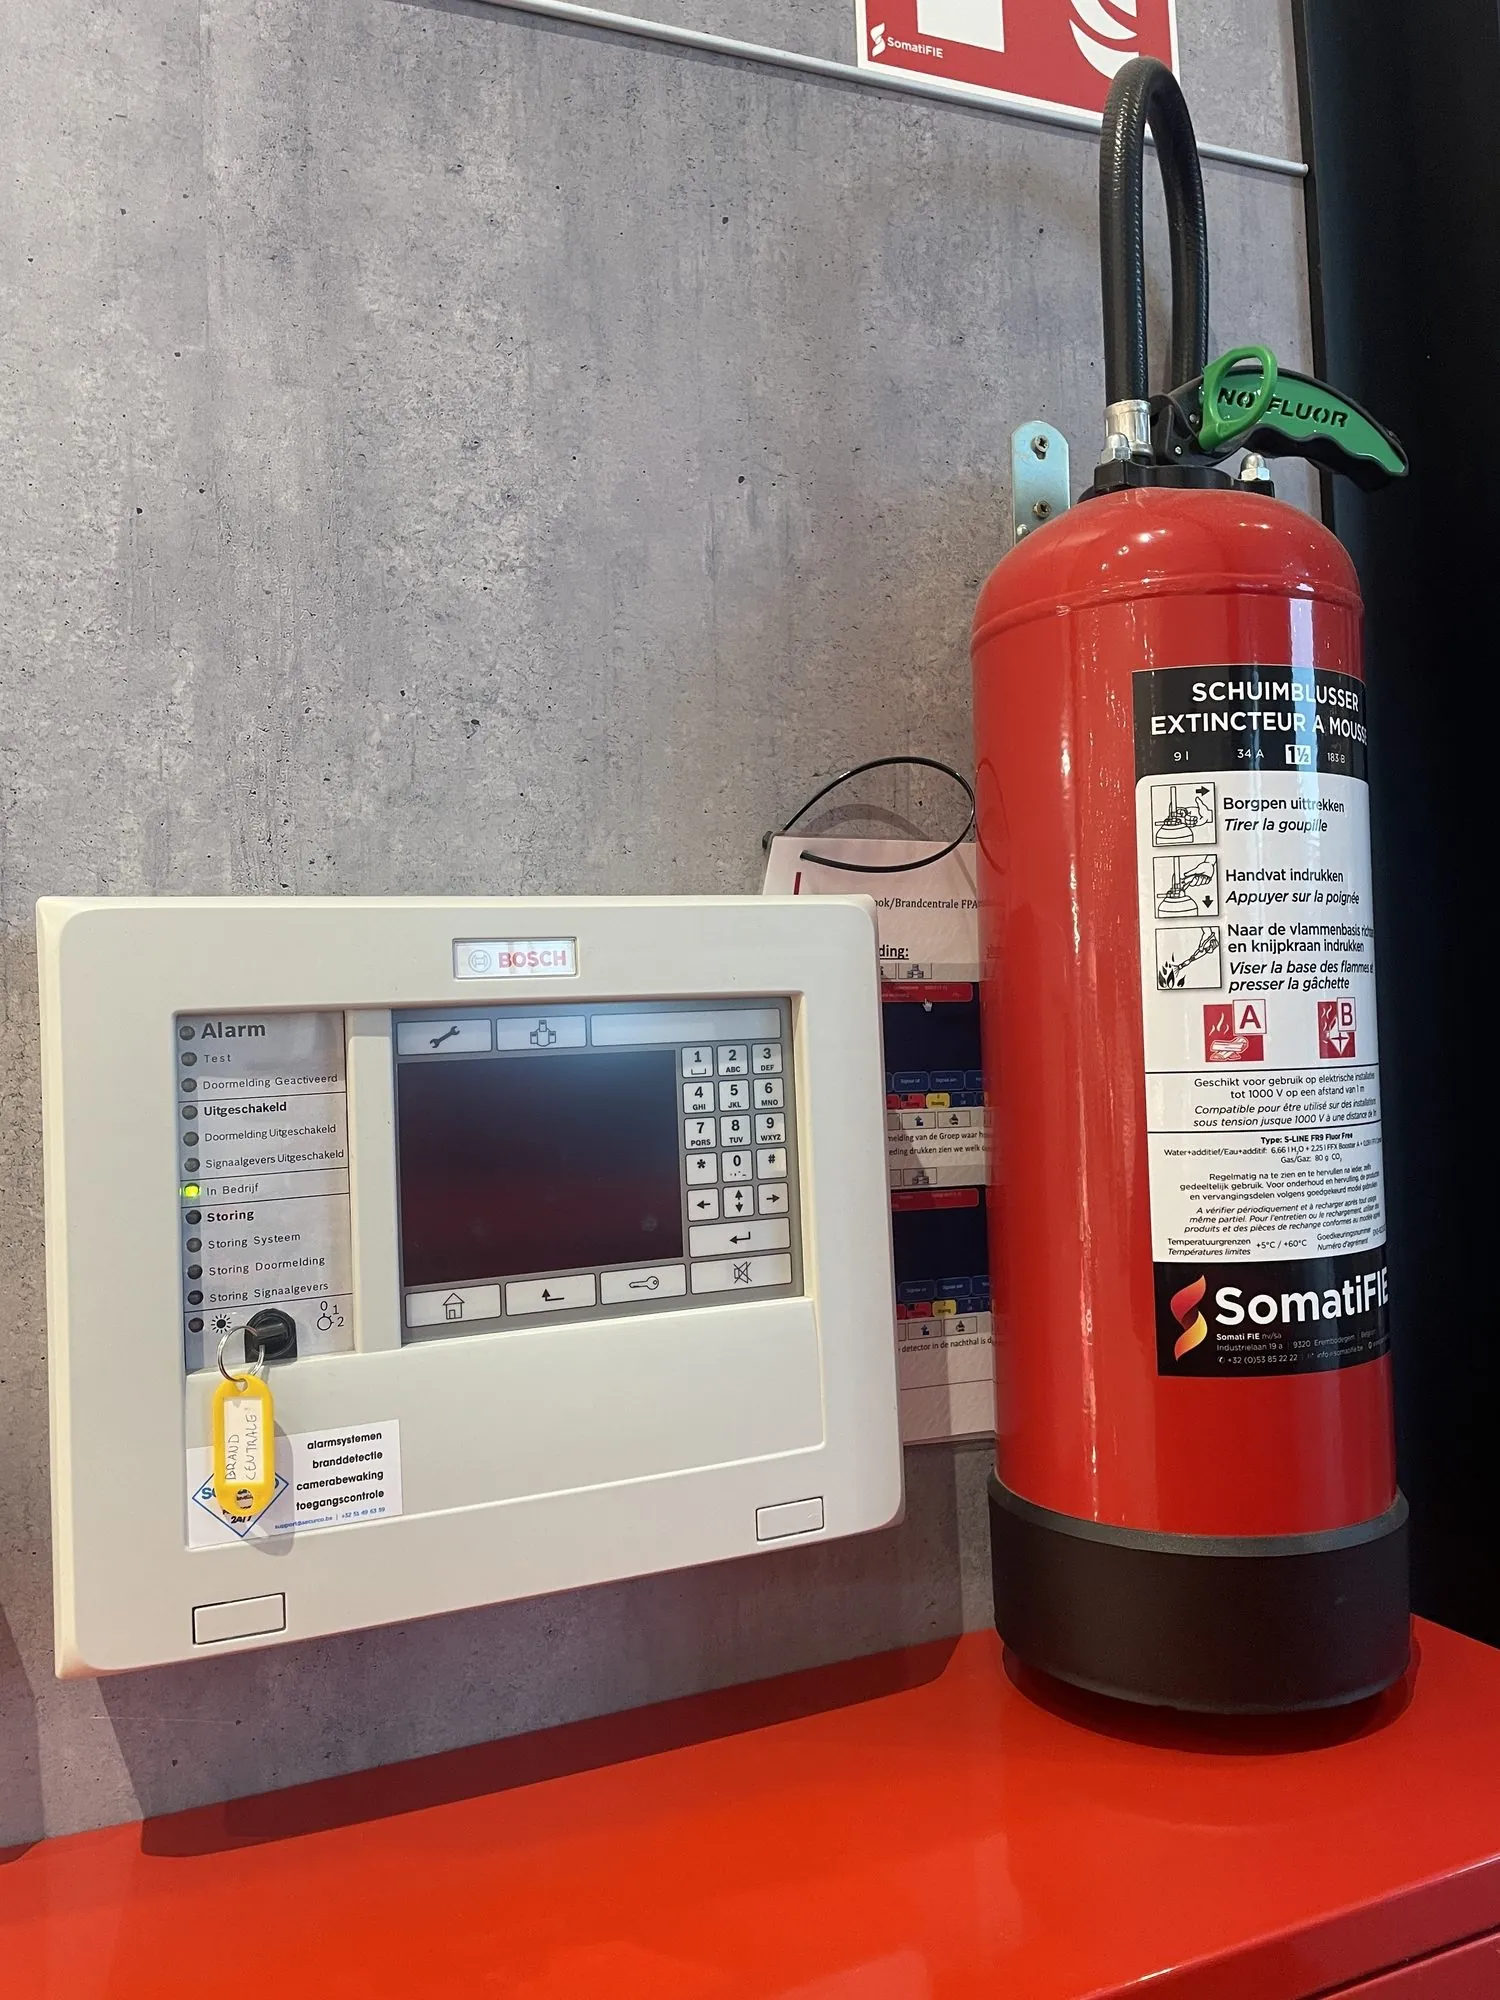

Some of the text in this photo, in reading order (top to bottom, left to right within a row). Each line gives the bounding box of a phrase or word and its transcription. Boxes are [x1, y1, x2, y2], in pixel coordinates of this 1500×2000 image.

[887, 36, 944, 59] SomatiFIE
[1218, 387, 1348, 427] NO FLUOR
[1192, 681, 1359, 711] SCHUIMBLUSSER
[1151, 712, 1305, 735] EXTINCTEUR
[1312, 715, 1325, 733] A
[1174, 752, 1181, 761] 9
[1237, 749, 1251, 758] 34
[1256, 750, 1264, 758] A
[1328, 753, 1339, 762] 183
[1341, 755, 1345, 763] B
[1224, 797, 1344, 813] Borgpen uittrekken
[1224, 818, 1327, 833] Tirer la goupille
[1226, 869, 1343, 882] Handvat indrukken
[1226, 890, 1360, 905] Appuyer sur la poignée
[1228, 924, 1263, 936] Naar
[1268, 923, 1285, 935] de
[1289, 923, 1361, 936] vlammenbasis
[1228, 939, 1364, 954] en knijpkraan indrukken
[499, 951, 566, 968] BOSCH
[1230, 961, 1267, 974] Viser
[1271, 961, 1282, 973] la
[1286, 960, 1316, 973] base
[1320, 960, 1338, 972] des
[1341, 960, 1369, 973] flammes
[1229, 977, 1349, 993] presser la gâchette
[1239, 1004, 1261, 1029] A
[1341, 1003, 1353, 1026] B
[201, 1022, 266, 1039] Alarm
[204, 1054, 231, 1063] Test
[694, 1051, 701, 1062] 1
[729, 1050, 736, 1061] 2
[763, 1048, 771, 1059] 3
[203, 1074, 338, 1089] Doormelding Geactiveerd
[1194, 1078, 1240, 1087] Geschikt
[1268, 1076, 1303, 1086] gebruik
[1319, 1073, 1353, 1083] elektrische
[695, 1087, 703, 1098] 4
[730, 1084, 738, 1096] 5
[765, 1082, 773, 1093] 6
[1249, 1089, 1273, 1098] 1000
[1276, 1089, 1283, 1097] V
[1318, 1086, 1344, 1095] afstand
[204, 1102, 287, 1117] Uitgeschakeld
[1195, 1105, 1255, 1115] Compatible
[1257, 1106, 1280, 1114] pour
[1304, 1101, 1326, 1110] utilisé
[732, 1120, 740, 1131] 8
[766, 1117, 774, 1128] 9
[1221, 1117, 1258, 1126] tension
[1260, 1117, 1292, 1127] jusque
[1295, 1114, 1316, 1123] 1000
[205, 1125, 336, 1141] Doormelding Uitgeschakeld
[696, 1122, 704, 1134] 7
[1261, 1136, 1282, 1144] Type:
[1285, 1135, 1308, 1143] S-LINE
[910, 1147, 936, 1155] drukken
[206, 1150, 344, 1169] Signaalgevers Uitgeschakeld
[733, 1155, 741, 1166] 0
[206, 1183, 259, 1196] In Bedrijf
[207, 1210, 254, 1222] Storing
[208, 1233, 300, 1249] Storing Systeem
[209, 1256, 325, 1275] Storing Doormelding
[210, 1283, 328, 1302] Storing Signaalgevers
[1215, 1267, 1388, 1325] SomatiFIE
[321, 1301, 328, 1311] 0
[333, 1304, 339, 1315] 1
[338, 1317, 344, 1327] 2
[902, 1343, 930, 1352] detector
[1293, 1340, 1311, 1348] 9320
[307, 1432, 382, 1449] alarmsystemen
[312, 1451, 383, 1469] branddetectie
[297, 1471, 384, 1491] camerabewaking
[296, 1490, 384, 1510] toegangscontrole
